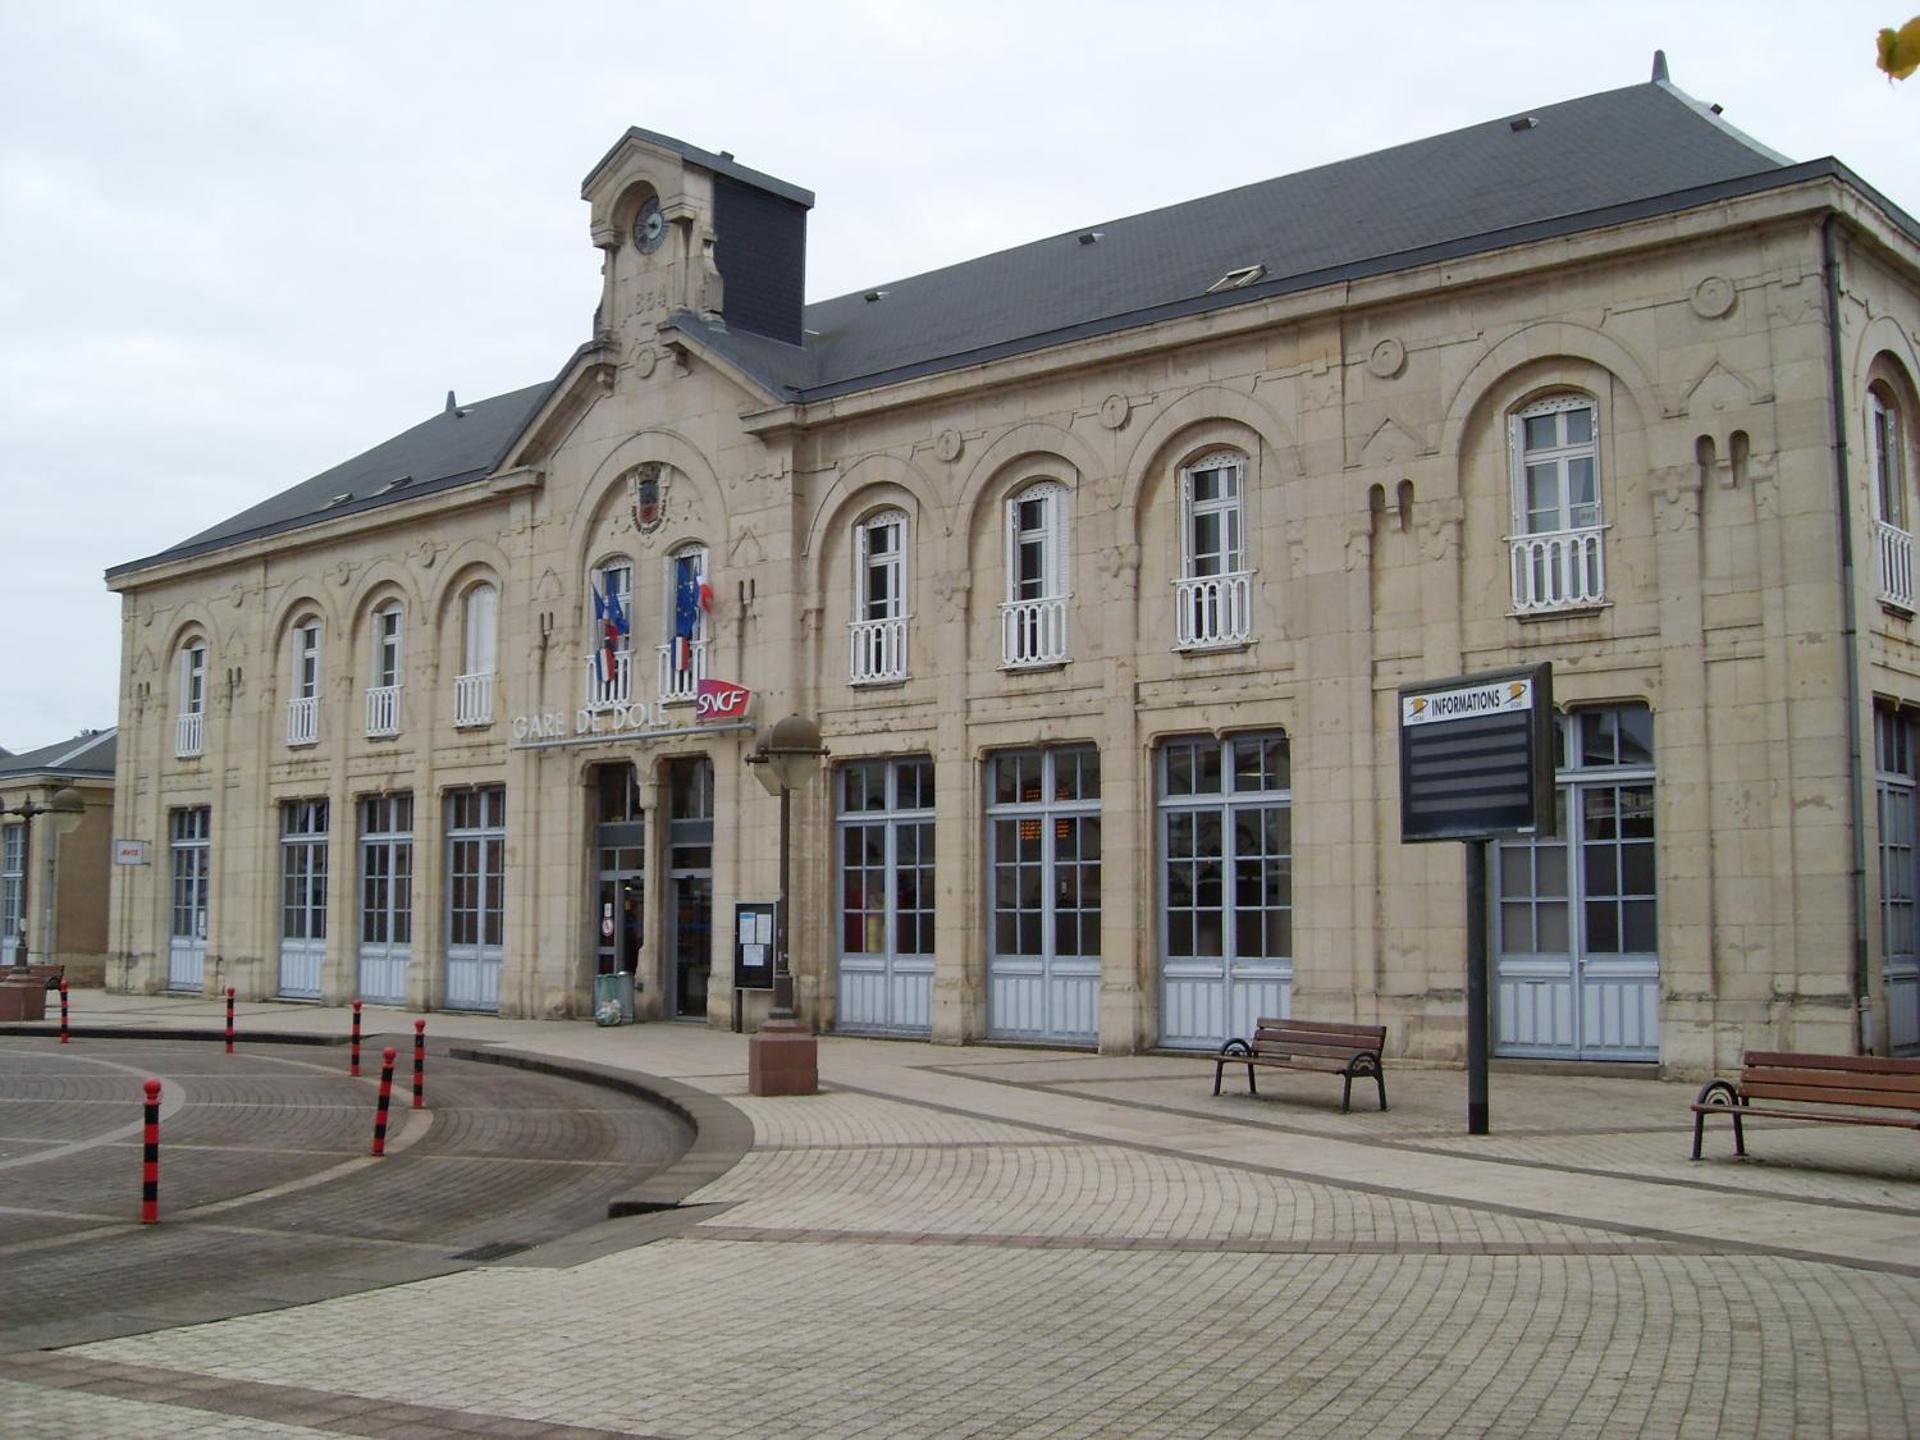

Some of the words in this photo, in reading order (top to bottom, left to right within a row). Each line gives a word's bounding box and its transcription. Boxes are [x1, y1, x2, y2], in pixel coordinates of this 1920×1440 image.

[697, 690, 745, 715] SNCF
[1432, 690, 1500, 716] INFORMATIONS
[512, 712, 566, 739] GARE
[576, 709, 603, 734] DE
[612, 701, 670, 729] DOLE
